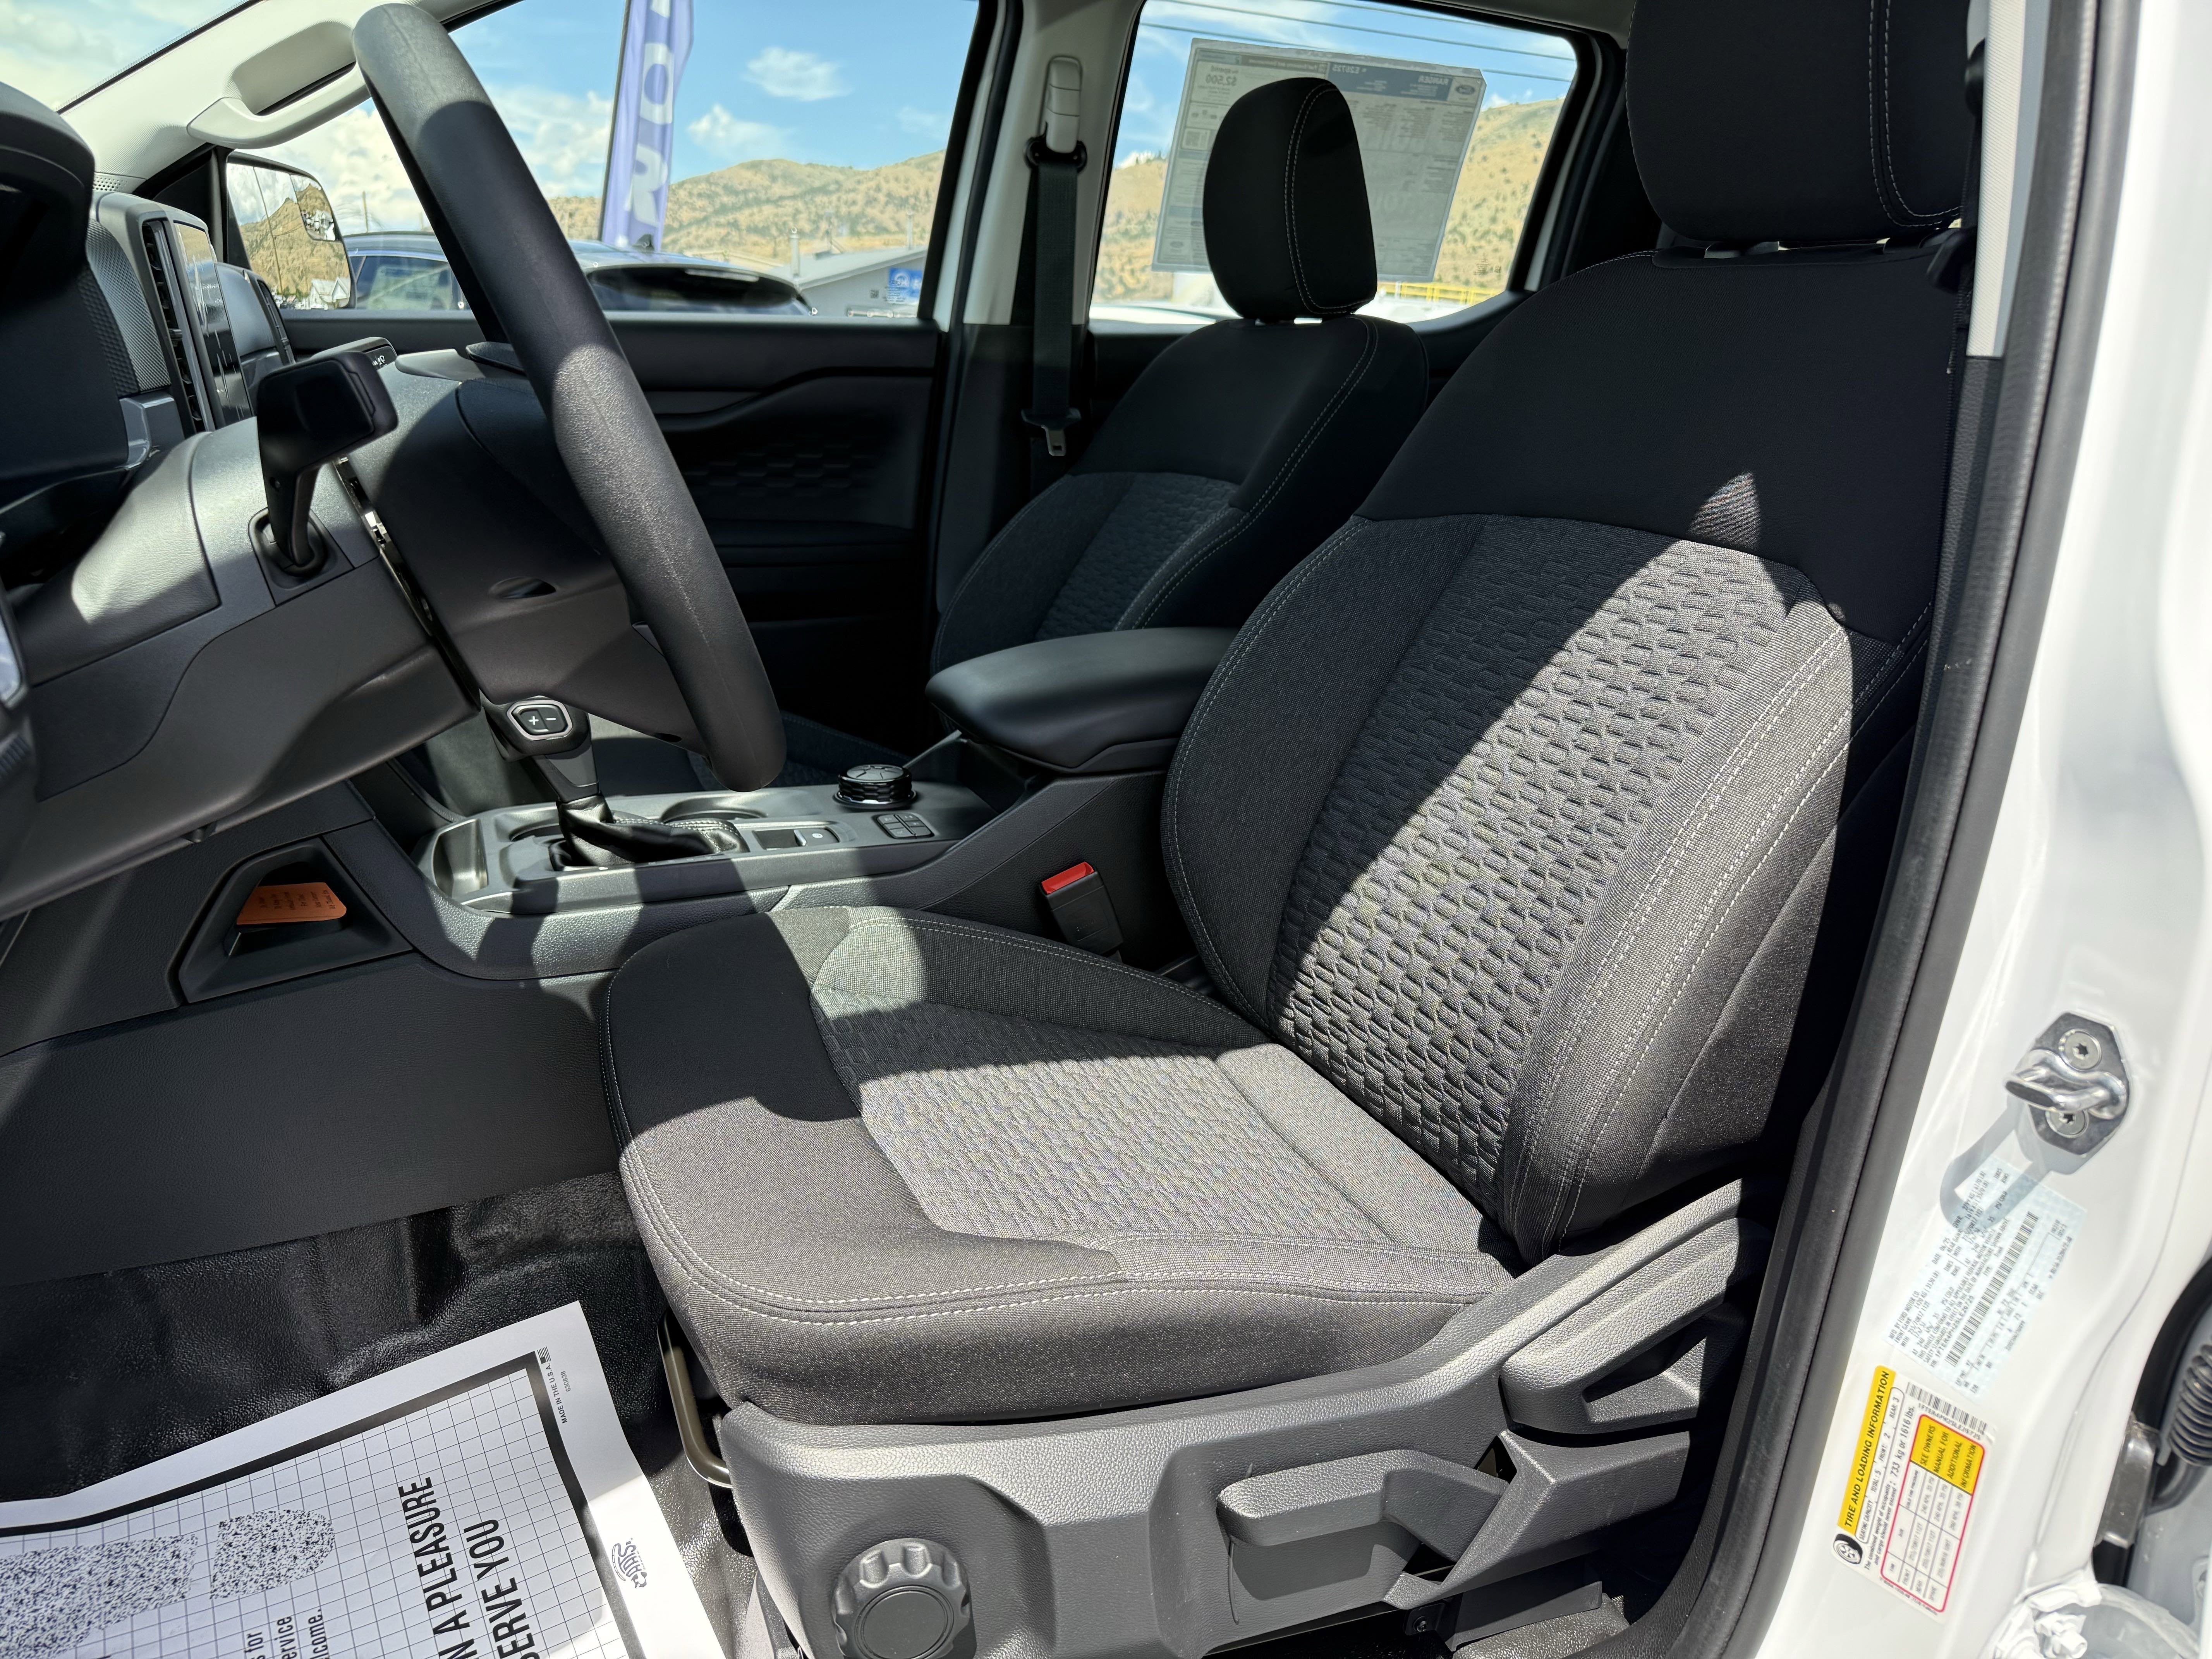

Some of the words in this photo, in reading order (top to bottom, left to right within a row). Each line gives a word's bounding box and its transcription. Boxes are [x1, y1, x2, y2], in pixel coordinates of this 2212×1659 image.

[2000, 1172, 2010, 1184] RIMS
[1951, 1244, 1962, 1257] WITH
[1975, 1243, 1987, 1260] MOTOR
[1950, 1264, 1961, 1277] RIMS
[1965, 1259, 1979, 1277] FEDERAL
[1923, 1348, 1936, 1364] SAFETY
[1931, 1325, 1949, 1350] STANDARDS
[1960, 1292, 1968, 1302] THE
[1964, 1281, 1974, 1294] DATE
[1973, 1247, 1994, 1277] MANUFACTURE
[1990, 1231, 2003, 1248] SHOWN
[1944, 1286, 1955, 1299] COLD
[1951, 1275, 1969, 1300] APPLICABLE
[1897, 1310, 1908, 1323] FORD
[1903, 1296, 1916, 1312] MOTOR
[1899, 1335, 1910, 1348] WITH
[1943, 1259, 1954, 1273] TIRES
[1940, 1297, 1949, 1306] PSI
[1944, 1305, 1952, 1313] TO
[1947, 1298, 1956, 1307] ALL
[1893, 1329, 1905, 1343] FRONT
[1920, 1290, 1928, 1298] KG
[1931, 1311, 1948, 1335] CONFORMS
[1922, 1333, 1935, 1350] VEHICLE
[1917, 1348, 1926, 1360] THIS
[545, 1362, 555, 1382] U.S.A.
[560, 1371, 570, 1392] 630838
[551, 1383, 560, 1396] THE
[558, 1405, 567, 1423] MADE
[1866, 1370, 1890, 1439] INFORMATION
[1904, 1403, 1915, 1420] lbs.
[1899, 1417, 1911, 1439] 1616
[1922, 1423, 1936, 1453] OWNERS
[1894, 1448, 1905, 1460] kg
[1898, 1439, 1906, 1449] or
[1932, 1445, 1945, 1474] MANUAL
[1939, 1431, 1949, 1446] FOR
[1855, 1439, 1873, 1483] LOADING
[1889, 1460, 1901, 1478] 733
[1918, 1451, 1929, 1467] SEE
[1946, 1439, 1962, 1479] ADDITIONAL
[1959, 1443, 1977, 1489] INFORMATION
[1850, 1482, 1862, 1505] AND
[1888, 1486, 1897, 1506] exceed
[1843, 1504, 1856, 1528] TIRE
[1862, 1499, 1874, 1522] CAPACITY
[1867, 1534, 1878, 1560] combined
[1873, 1516, 1883, 1535] weight
[1879, 1520, 1888, 1539] should
[398, 1477, 462, 1611] PLEASURE
[463, 1519, 510, 1581] YOU
[1876, 1539, 1885, 1555] cargo
[432, 1609, 471, 1635] A
[244, 1632, 264, 1653] for
[274, 1616, 297, 1659] ervice
[308, 1608, 330, 1659] lcome.
